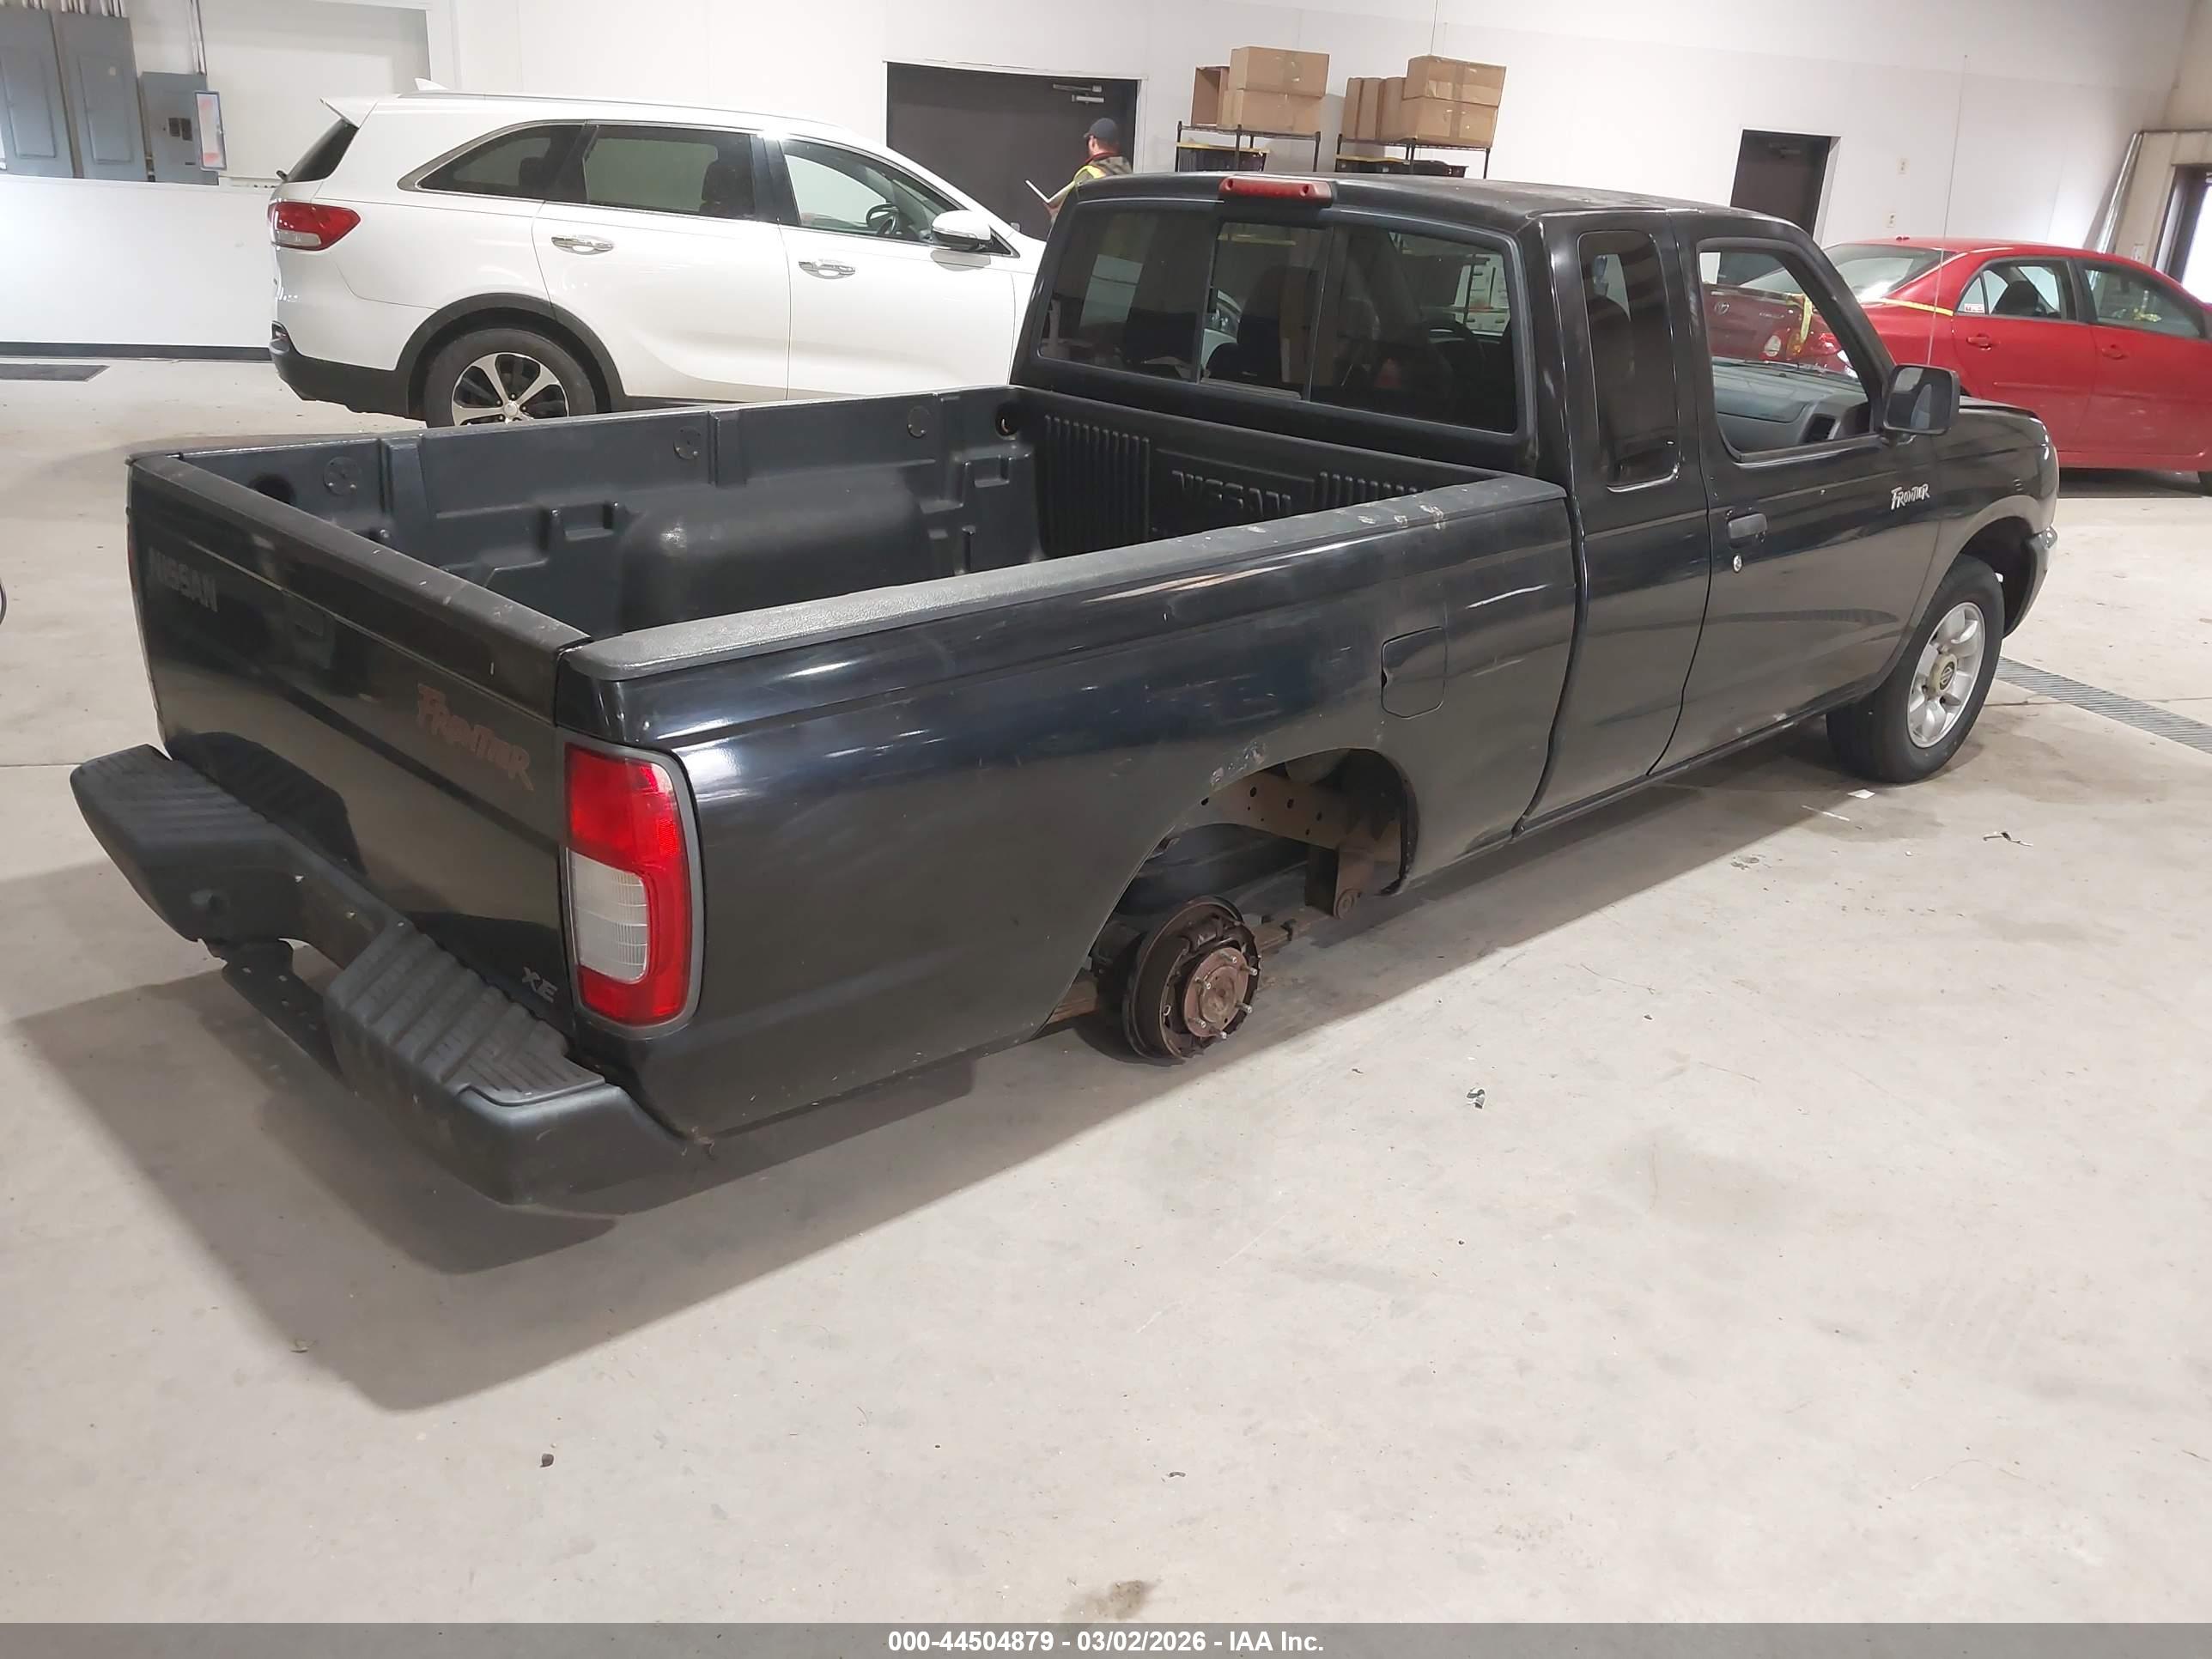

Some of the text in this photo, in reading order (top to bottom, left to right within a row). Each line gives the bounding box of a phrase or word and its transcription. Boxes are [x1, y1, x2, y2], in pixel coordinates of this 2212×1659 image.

[1890, 483, 1931, 511] FRONTIER
[147, 546, 218, 612] NISSAN
[416, 682, 535, 791] FRONTIER
[522, 966, 557, 1004] XE
